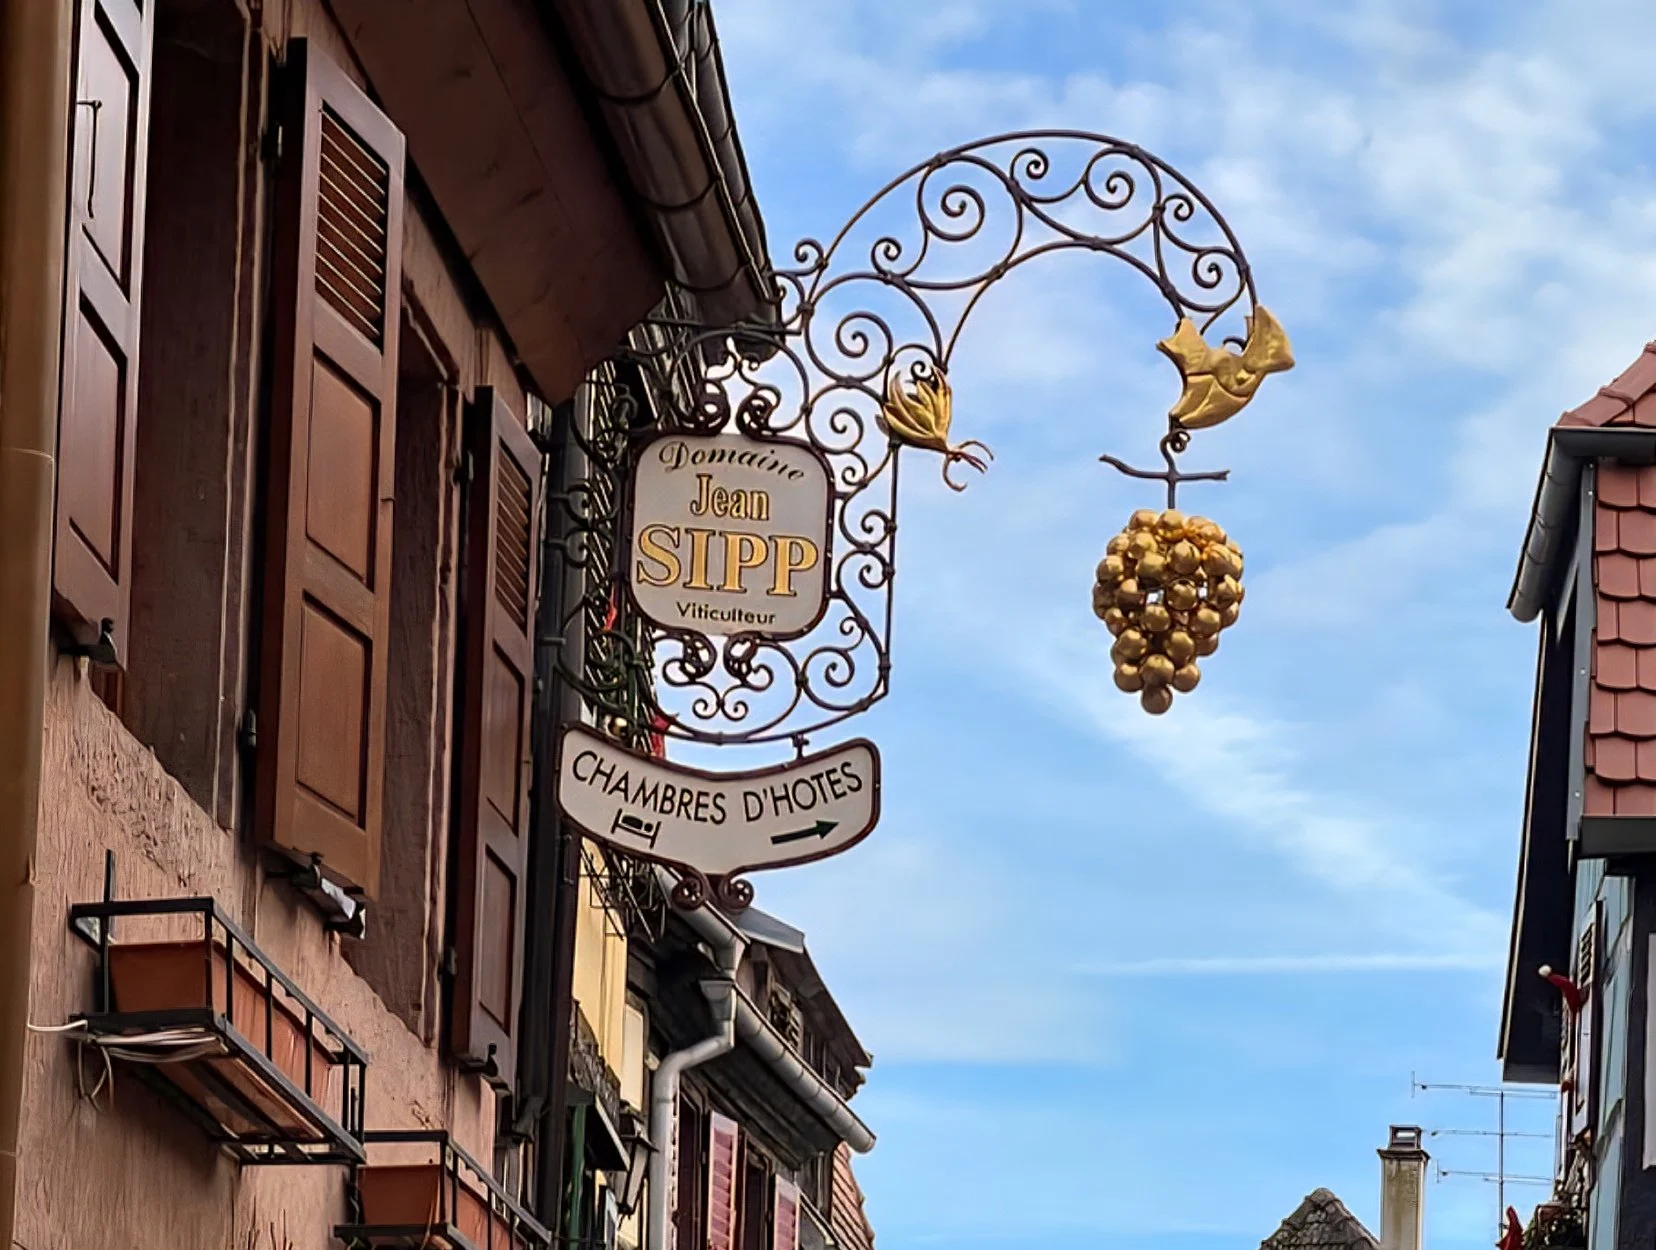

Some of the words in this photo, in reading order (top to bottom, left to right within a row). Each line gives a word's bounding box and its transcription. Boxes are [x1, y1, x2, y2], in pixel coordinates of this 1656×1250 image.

[658, 440, 804, 480] Domaine
[689, 473, 770, 521] Jean
[636, 524, 819, 597] SIPP
[676, 602, 776, 624] Viticulteur
[572, 750, 727, 825] CHAMBRES
[742, 761, 863, 822] D'HOTES
